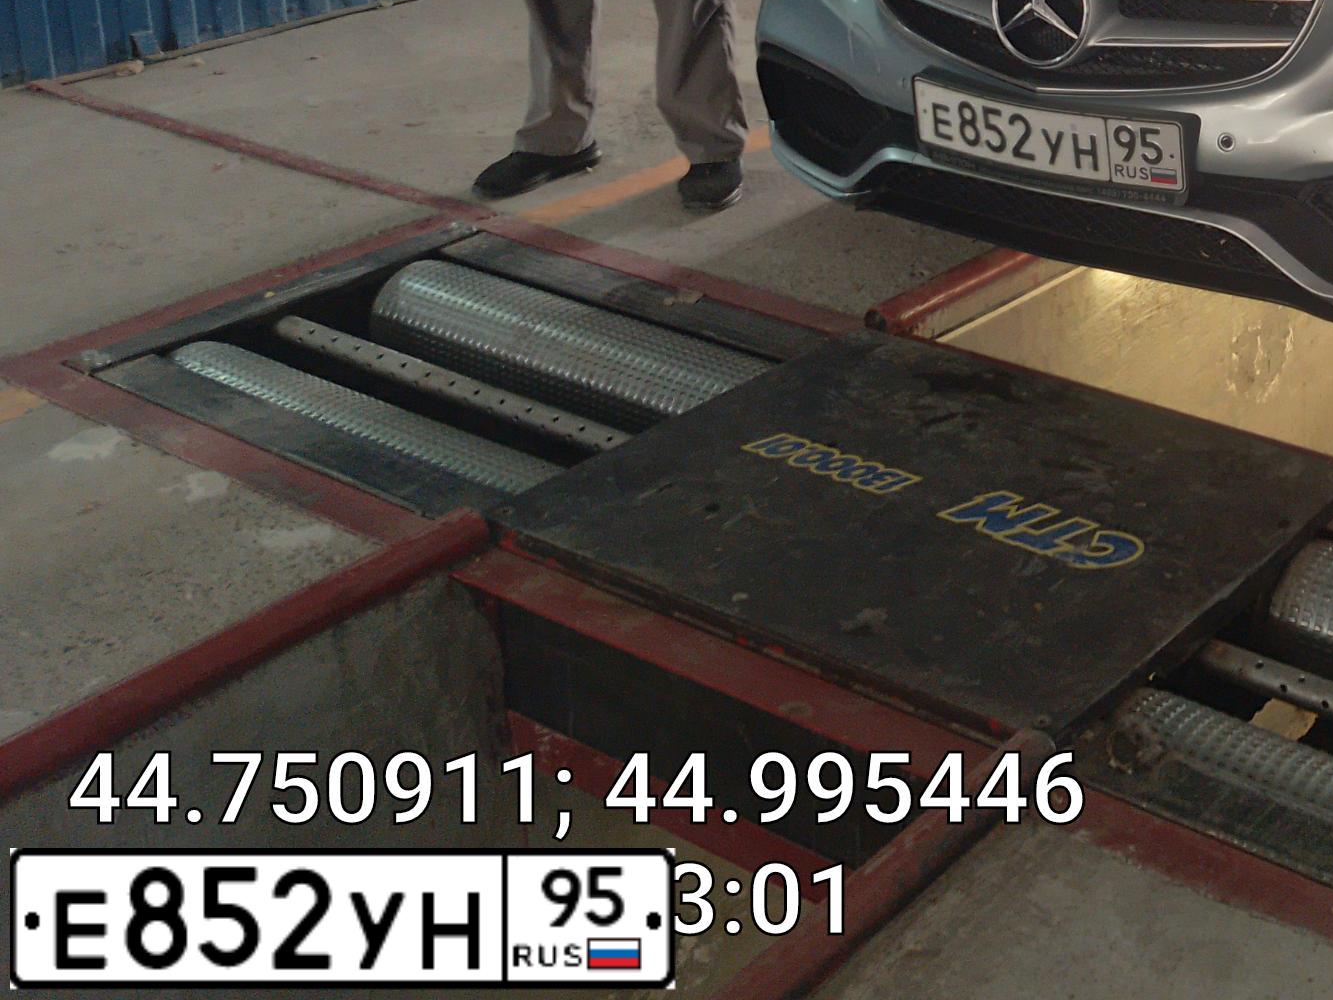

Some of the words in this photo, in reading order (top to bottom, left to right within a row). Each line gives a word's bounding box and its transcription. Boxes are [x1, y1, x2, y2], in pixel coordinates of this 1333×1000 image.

[931, 101, 1100, 172] Е852УН
[1113, 125, 1163, 165] 95
[1115, 165, 1149, 180] RUS
